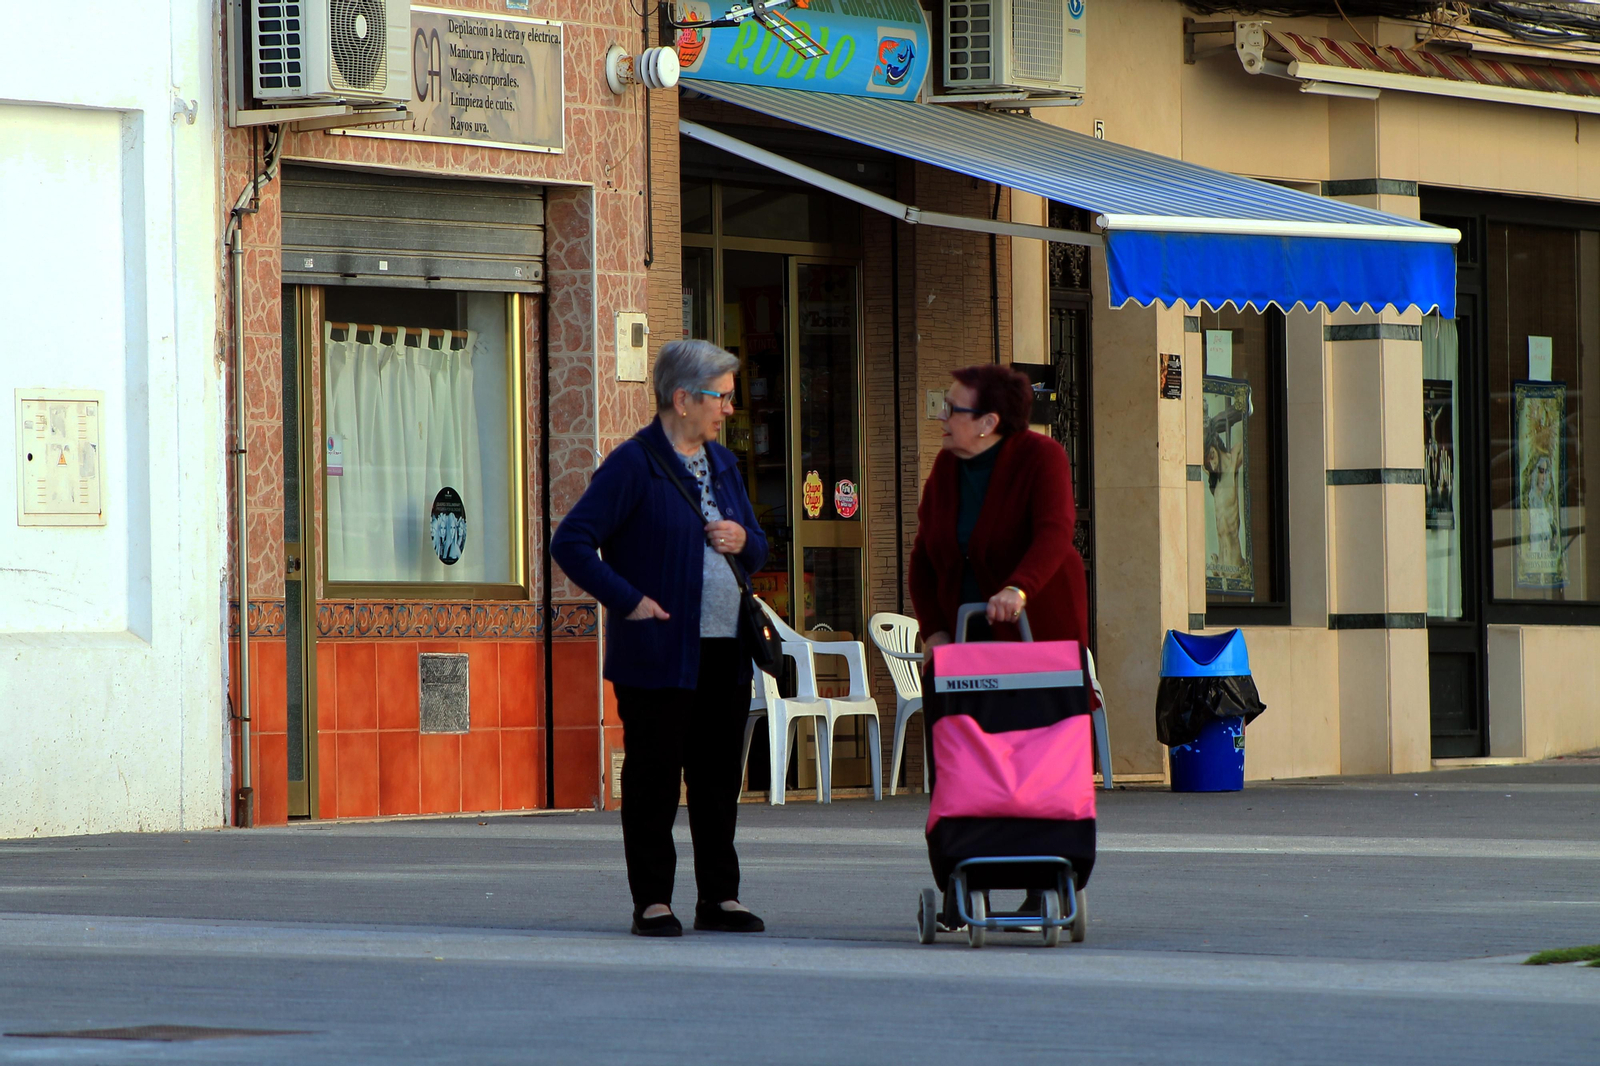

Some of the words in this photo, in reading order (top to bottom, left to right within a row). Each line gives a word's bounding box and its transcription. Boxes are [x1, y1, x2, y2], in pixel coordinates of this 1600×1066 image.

[448, 19, 488, 39] Depilación
[489, 28, 494, 37] a
[495, 23, 503, 39] la
[504, 30, 520, 40] cera
[521, 31, 526, 45] y
[527, 28, 561, 44] eléctrica.
[449, 43, 484, 60] Manicura
[485, 52, 490, 65] y
[492, 47, 526, 64] Pedicura.
[450, 67, 479, 88] Masajes
[480, 73, 520, 91] corporales.
[450, 91, 483, 112] Limpieza
[484, 94, 494, 110] de
[495, 97, 515, 112] cutis.
[450, 116, 473, 136] Rayos
[474, 122, 490, 133] uva.
[1096, 121, 1103, 140] 5
